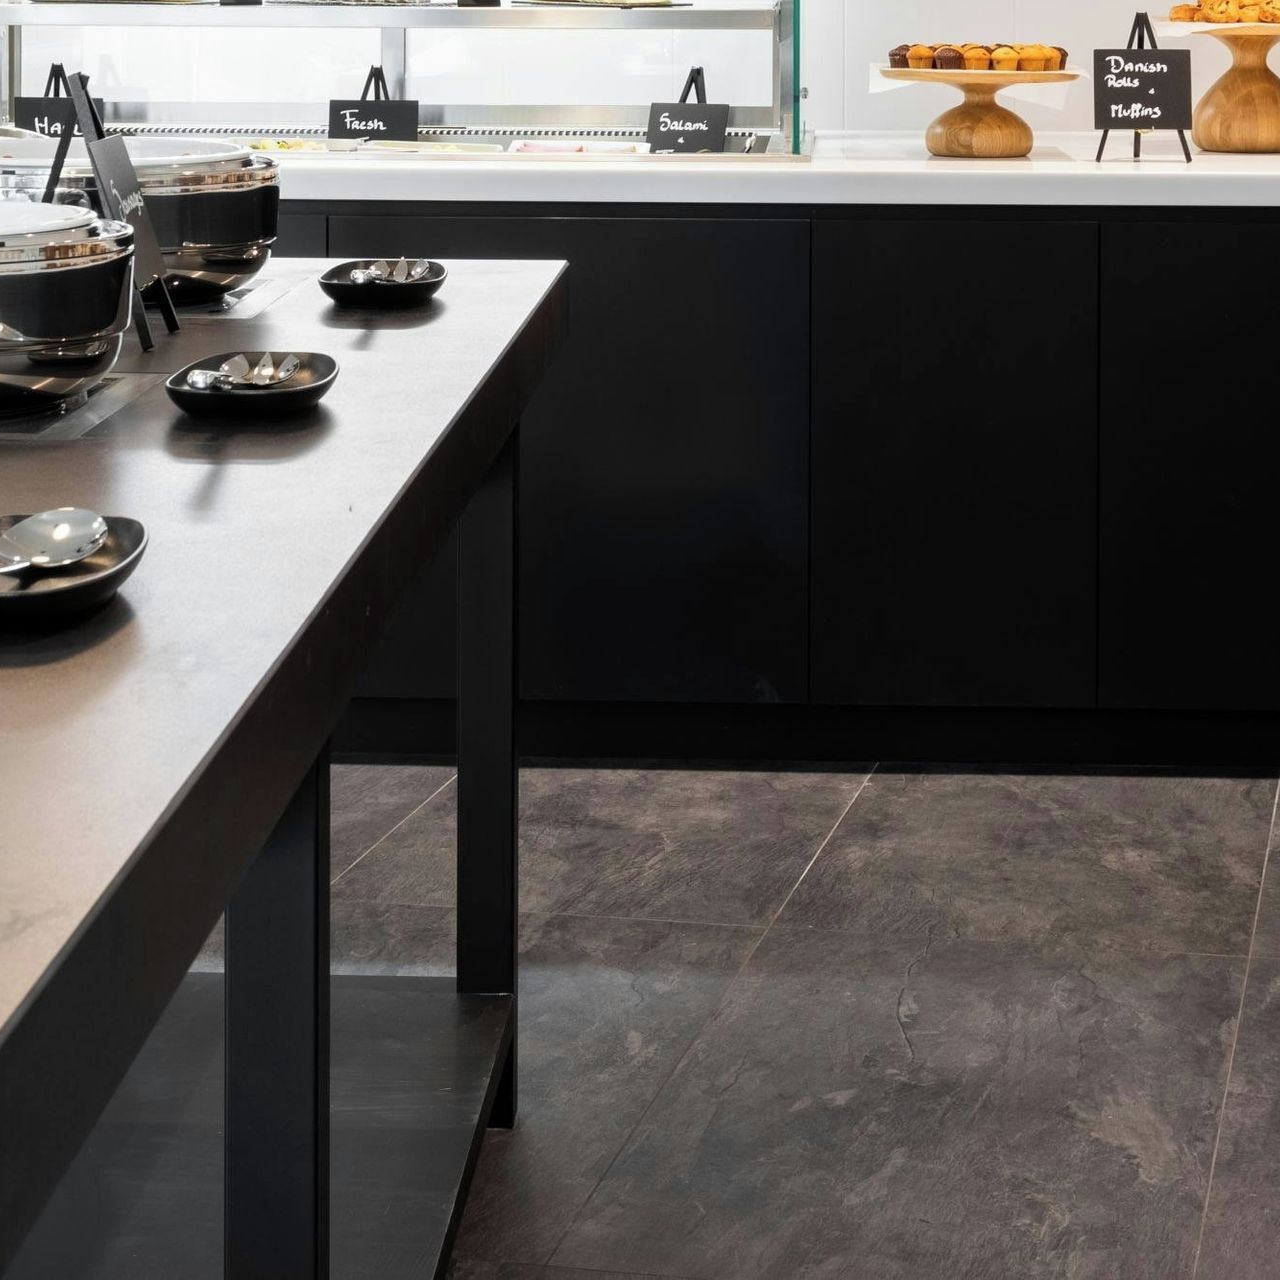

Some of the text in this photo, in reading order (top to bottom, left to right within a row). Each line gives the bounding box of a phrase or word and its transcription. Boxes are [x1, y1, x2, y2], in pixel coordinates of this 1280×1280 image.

[1105, 55, 1168, 73] Danish
[1104, 74, 1140, 88] Rolls
[1110, 102, 1162, 119] Muffins
[659, 112, 709, 132] Salami
